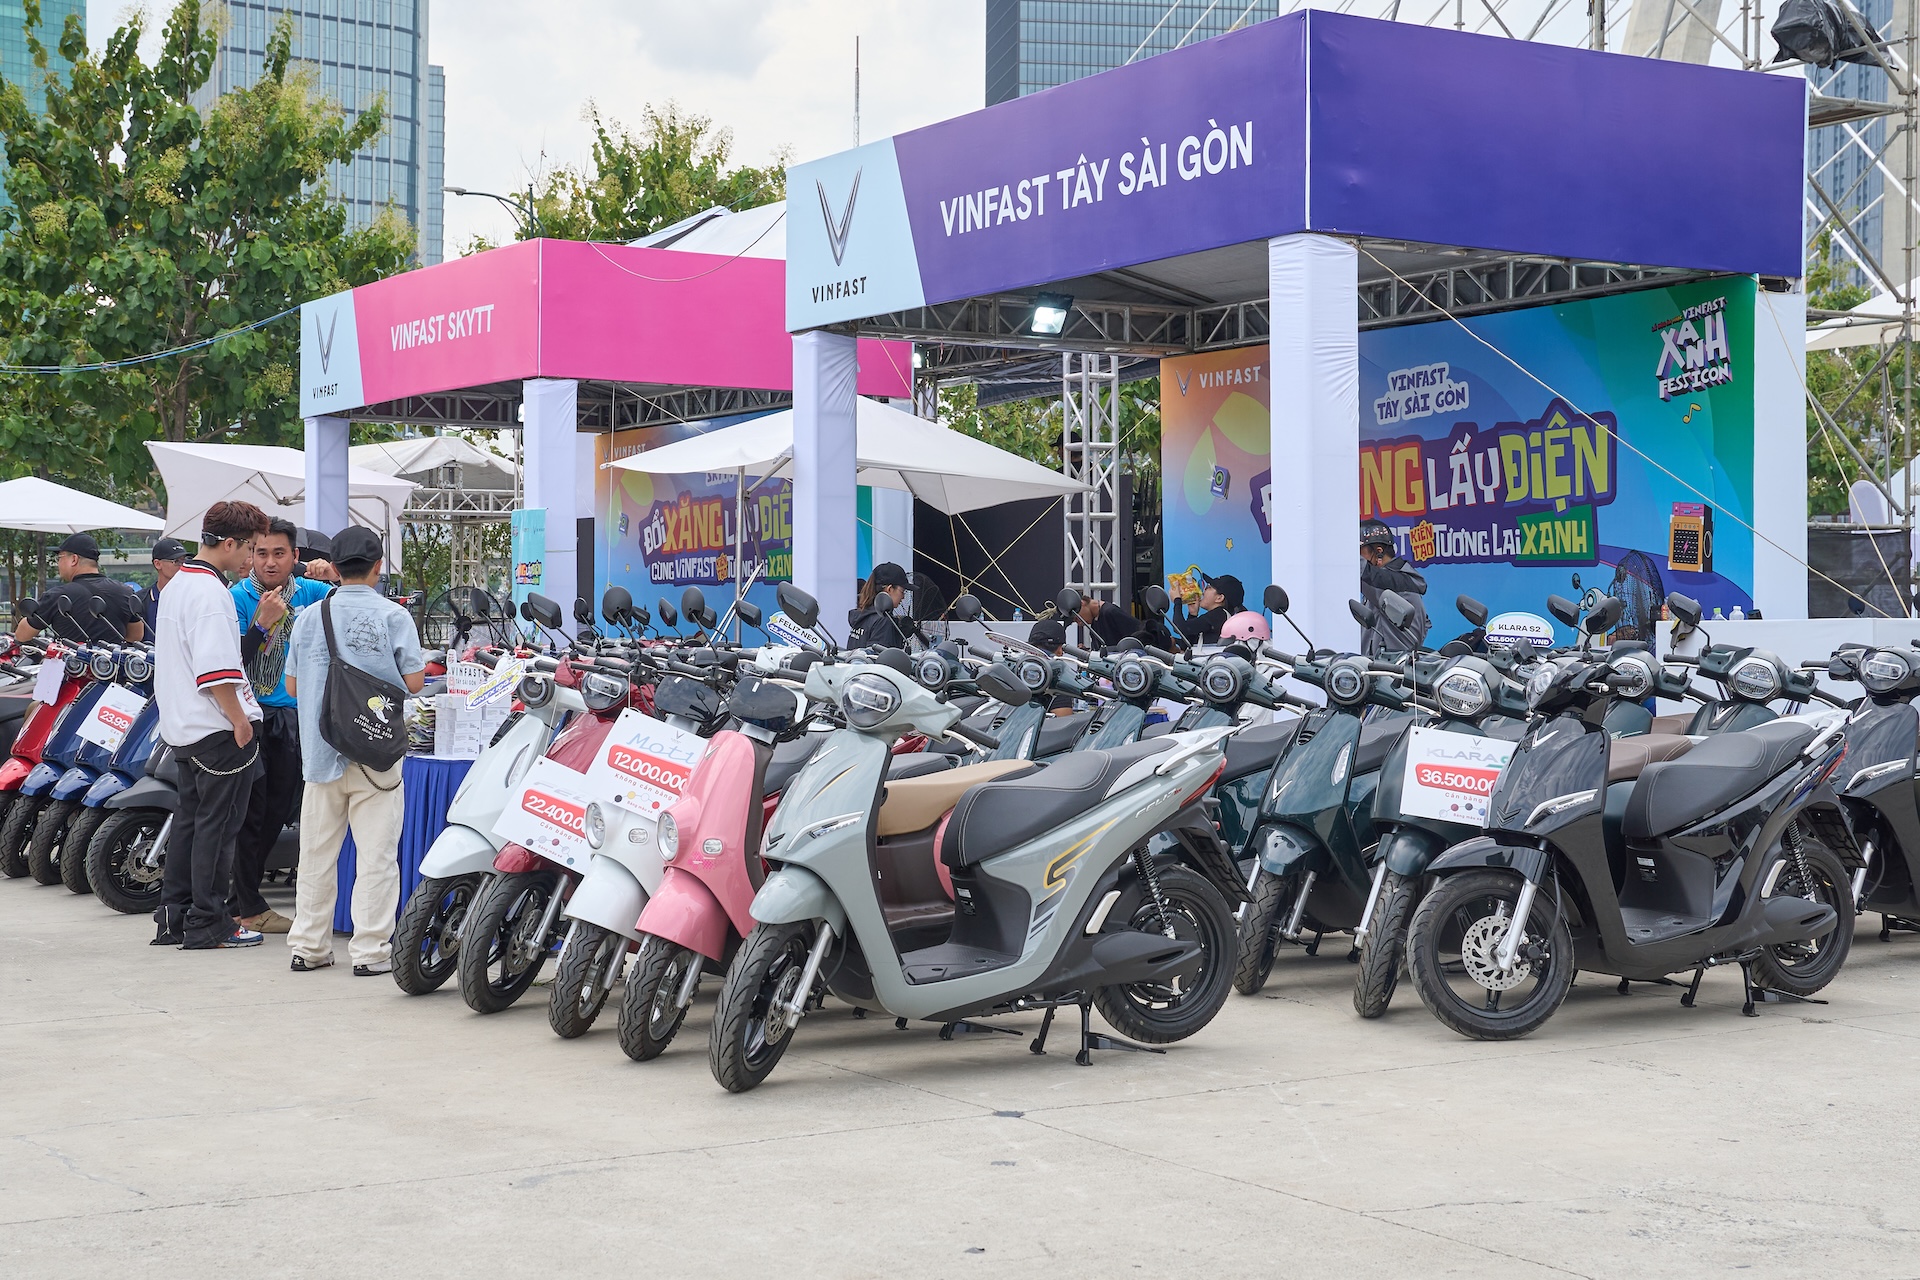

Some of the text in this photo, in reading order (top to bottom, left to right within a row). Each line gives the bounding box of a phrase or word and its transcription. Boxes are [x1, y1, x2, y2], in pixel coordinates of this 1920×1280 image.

[940, 119, 1253, 237] VINFAST TÂY SÀI GÒN
[811, 276, 867, 302] VINFAST
[1682, 296, 1726, 319] VINFAST
[390, 304, 494, 351] VINFAST SKYTT
[1199, 366, 1260, 388] VINFAST
[1390, 367, 1446, 391] VINFAST
[312, 383, 338, 399] VINFAST
[1377, 382, 1465, 420] TÂY SÀI GÒN
[1360, 446, 1425, 515] NG
[662, 498, 724, 552] XĂNG
[1433, 523, 1488, 557] TƯƠNG
[1521, 520, 1588, 555] XANH
[768, 554, 792, 577] XAN
[778, 617, 818, 644] FELIZ NEO
[1498, 623, 1528, 632] KLARA
[1533, 637, 1549, 645] VND
[100, 711, 130, 730] 23.99
[1426, 747, 1498, 763] KLARA
[614, 772, 637, 787] Không
